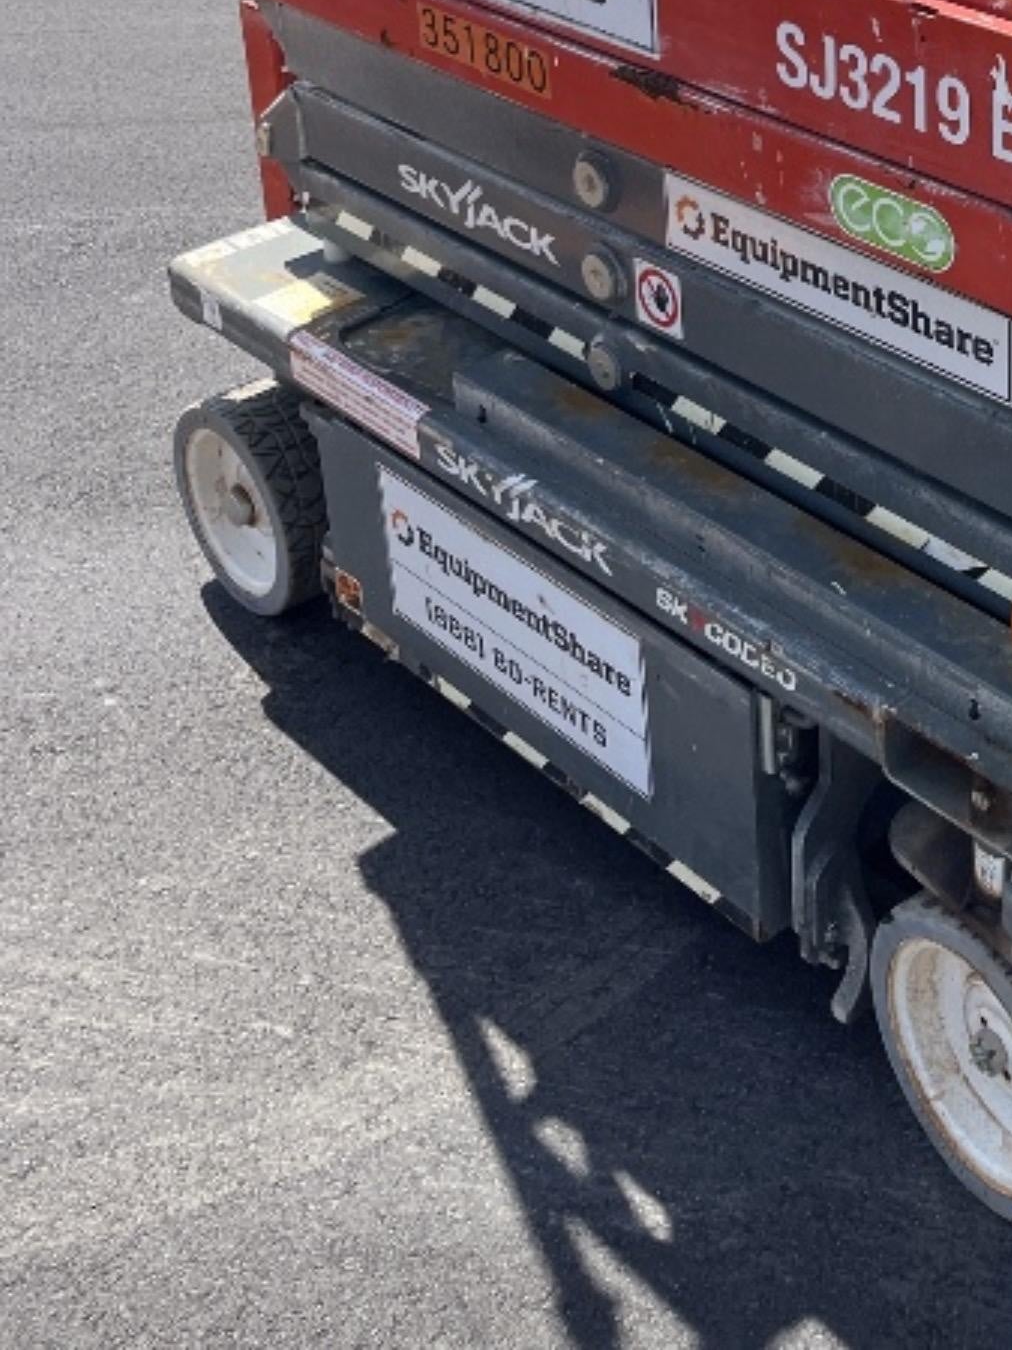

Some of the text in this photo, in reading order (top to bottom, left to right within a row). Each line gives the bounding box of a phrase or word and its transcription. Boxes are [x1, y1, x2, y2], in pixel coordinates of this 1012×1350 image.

[421, 8, 549, 93] 351800
[776, 21, 970, 146] SJ3219
[398, 163, 561, 267] SKYJACK
[839, 183, 947, 262] eco
[710, 212, 996, 366] EquipmentShare
[435, 442, 613, 576] SKYJACK
[417, 527, 632, 697] EquipmentShare
[425, 596, 608, 748] (888) 80-RENTS
